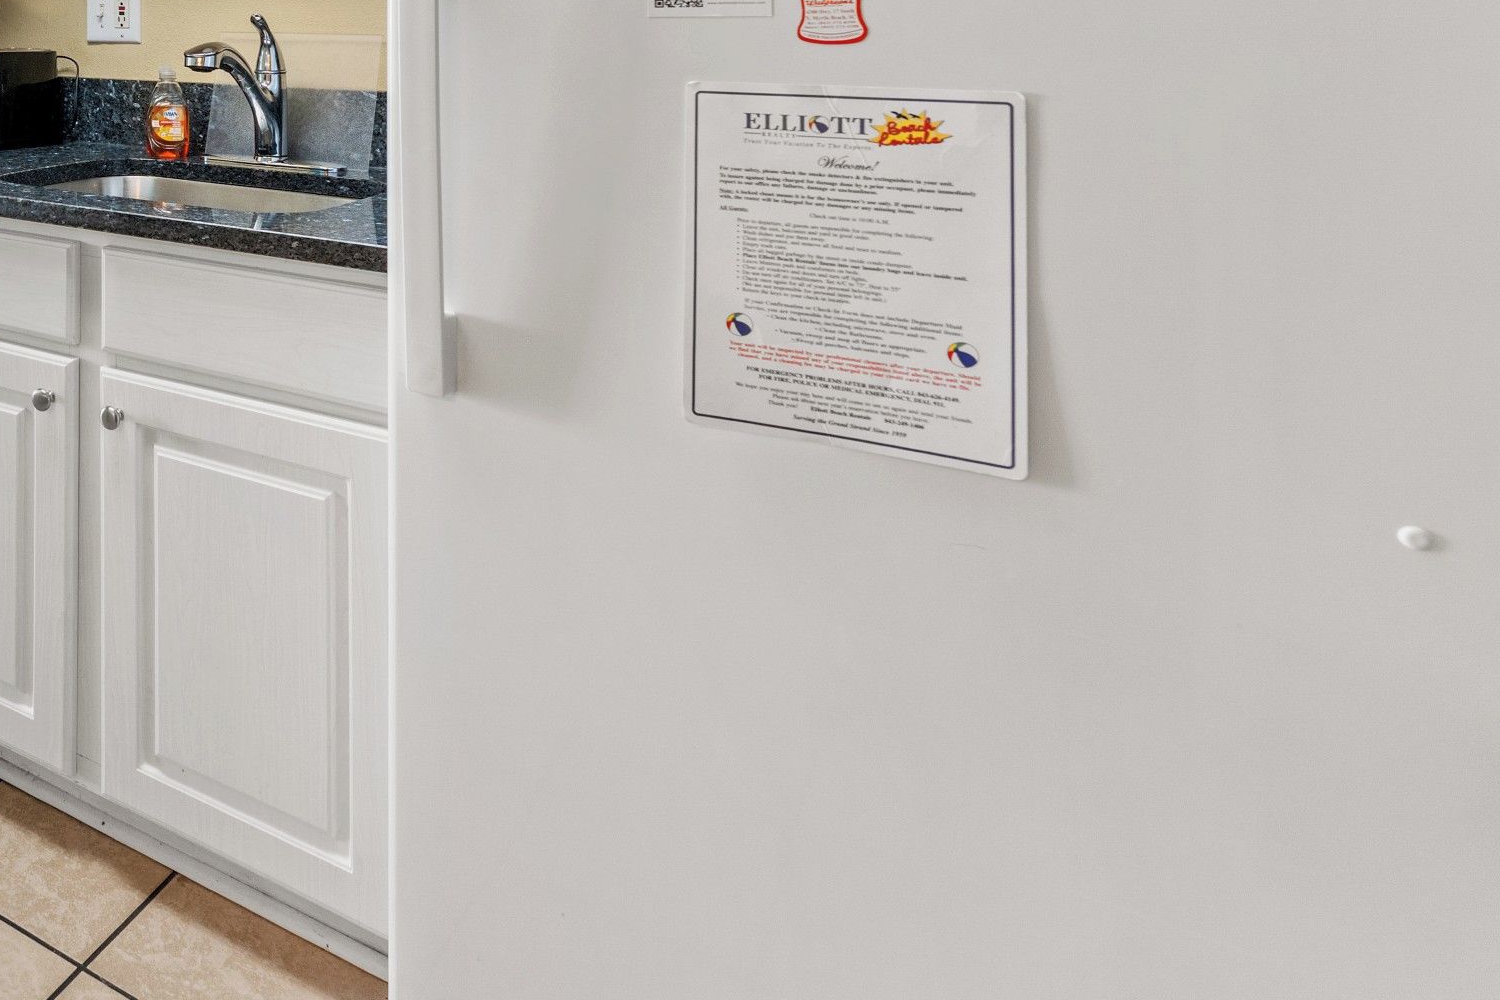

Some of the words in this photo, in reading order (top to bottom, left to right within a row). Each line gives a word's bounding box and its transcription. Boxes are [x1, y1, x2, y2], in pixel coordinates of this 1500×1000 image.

[887, 117, 934, 136] Beach
[878, 133, 945, 148] Rentals
[817, 155, 880, 172] Welcome!
